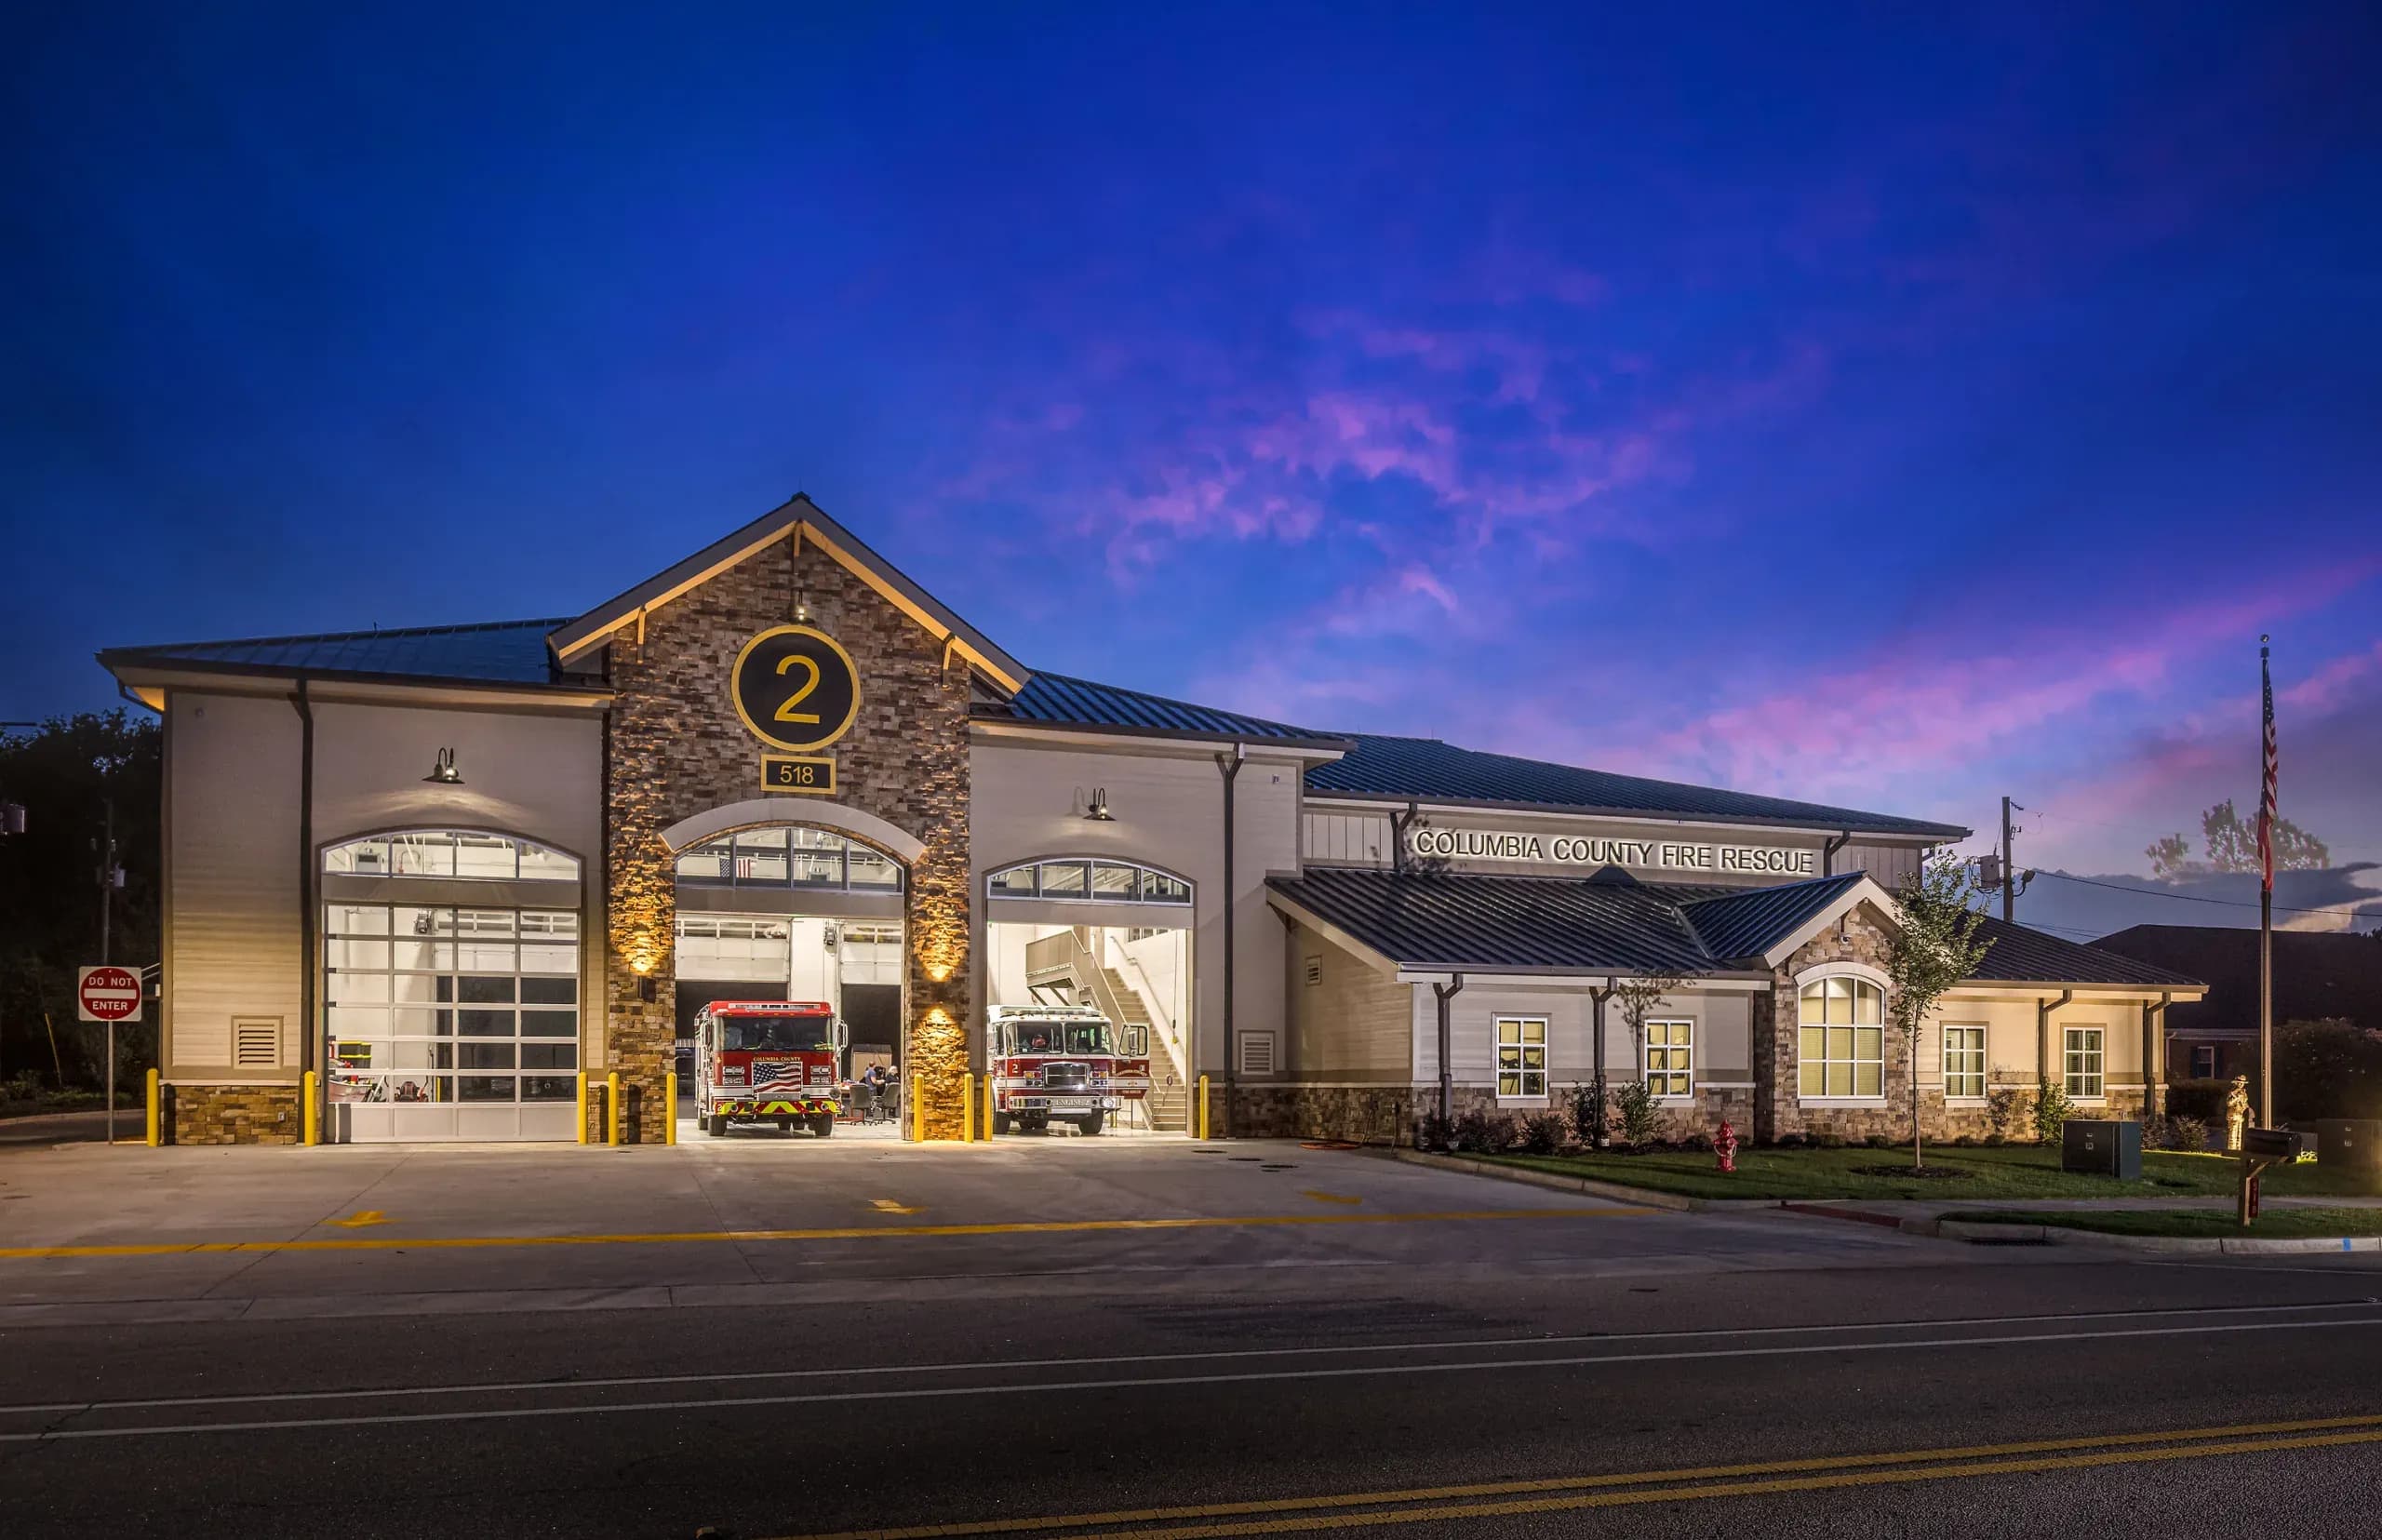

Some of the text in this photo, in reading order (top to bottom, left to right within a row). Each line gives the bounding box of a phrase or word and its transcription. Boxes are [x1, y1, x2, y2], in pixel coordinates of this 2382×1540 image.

[773, 654, 821, 724] 2
[780, 765, 814, 784] 518
[1415, 830, 1814, 874] COLUMBIA COUNTY FIRE RESCUE
[88, 976, 133, 987] DO NOT
[92, 1000, 128, 1011] ENTER
[1011, 1063, 1019, 1074] 2
